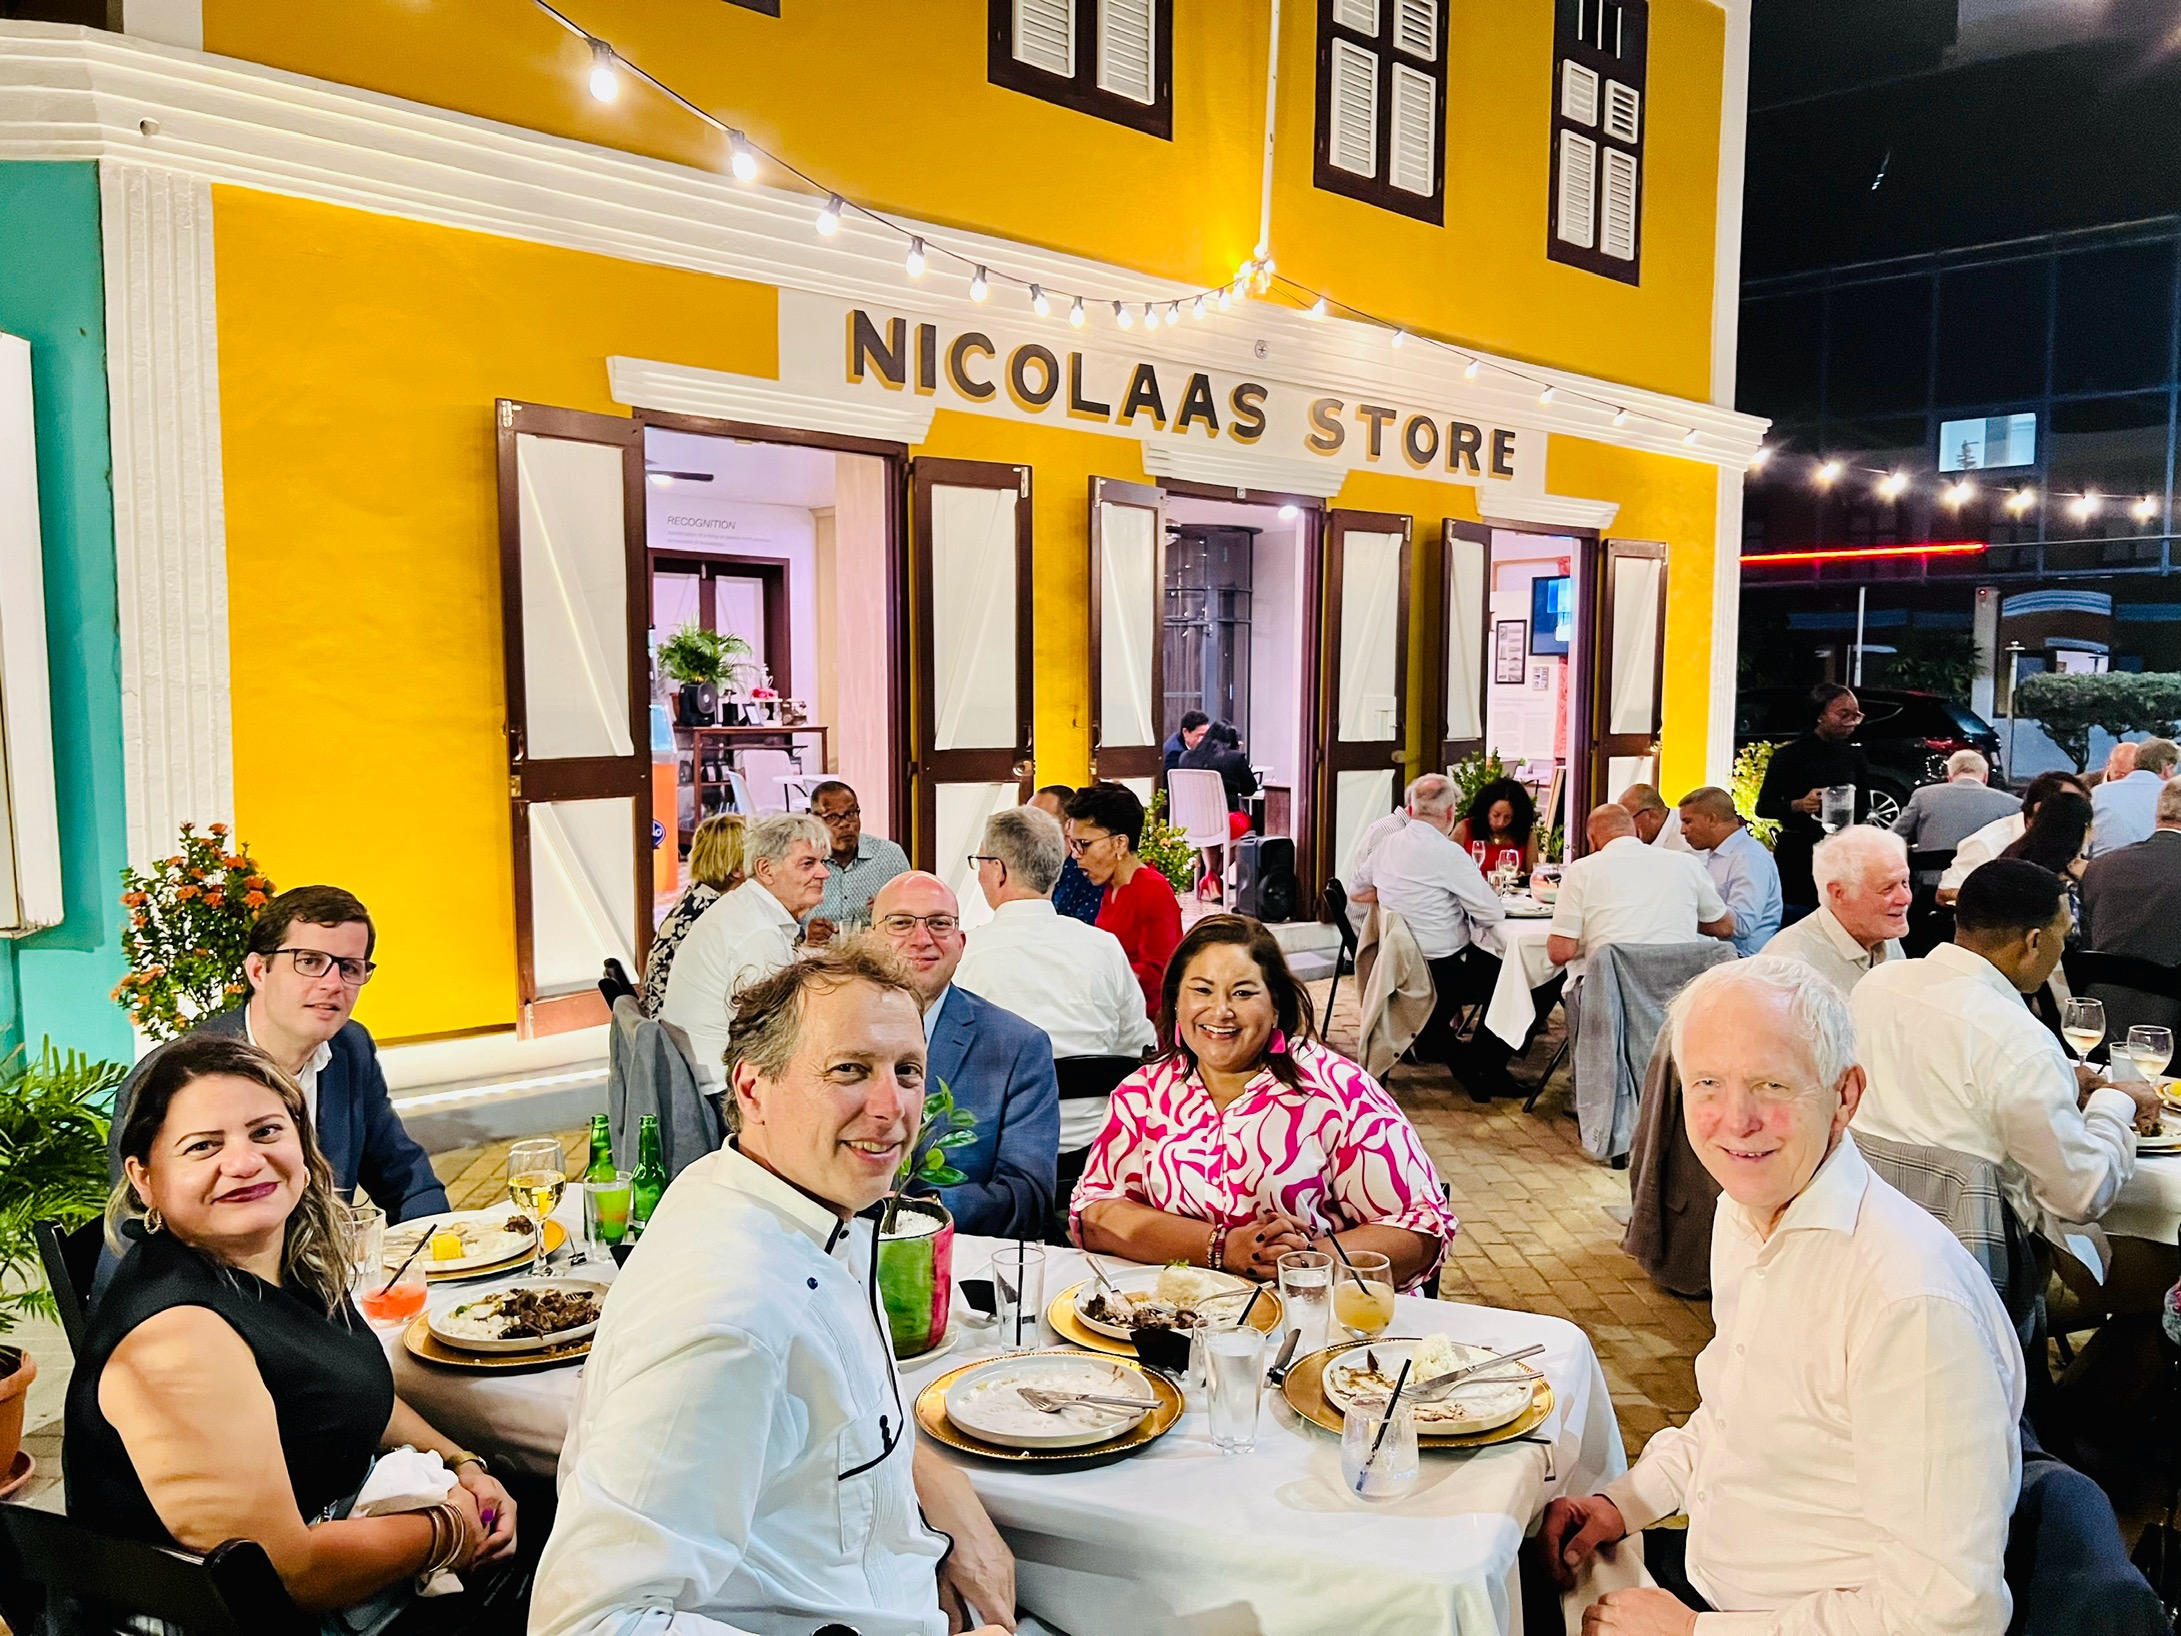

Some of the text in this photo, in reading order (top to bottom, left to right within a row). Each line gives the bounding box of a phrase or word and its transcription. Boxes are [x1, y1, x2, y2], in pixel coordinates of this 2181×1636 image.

[846, 309, 1516, 481] NICOLAAS STORE
[667, 516, 736, 530] RECOGNITION
